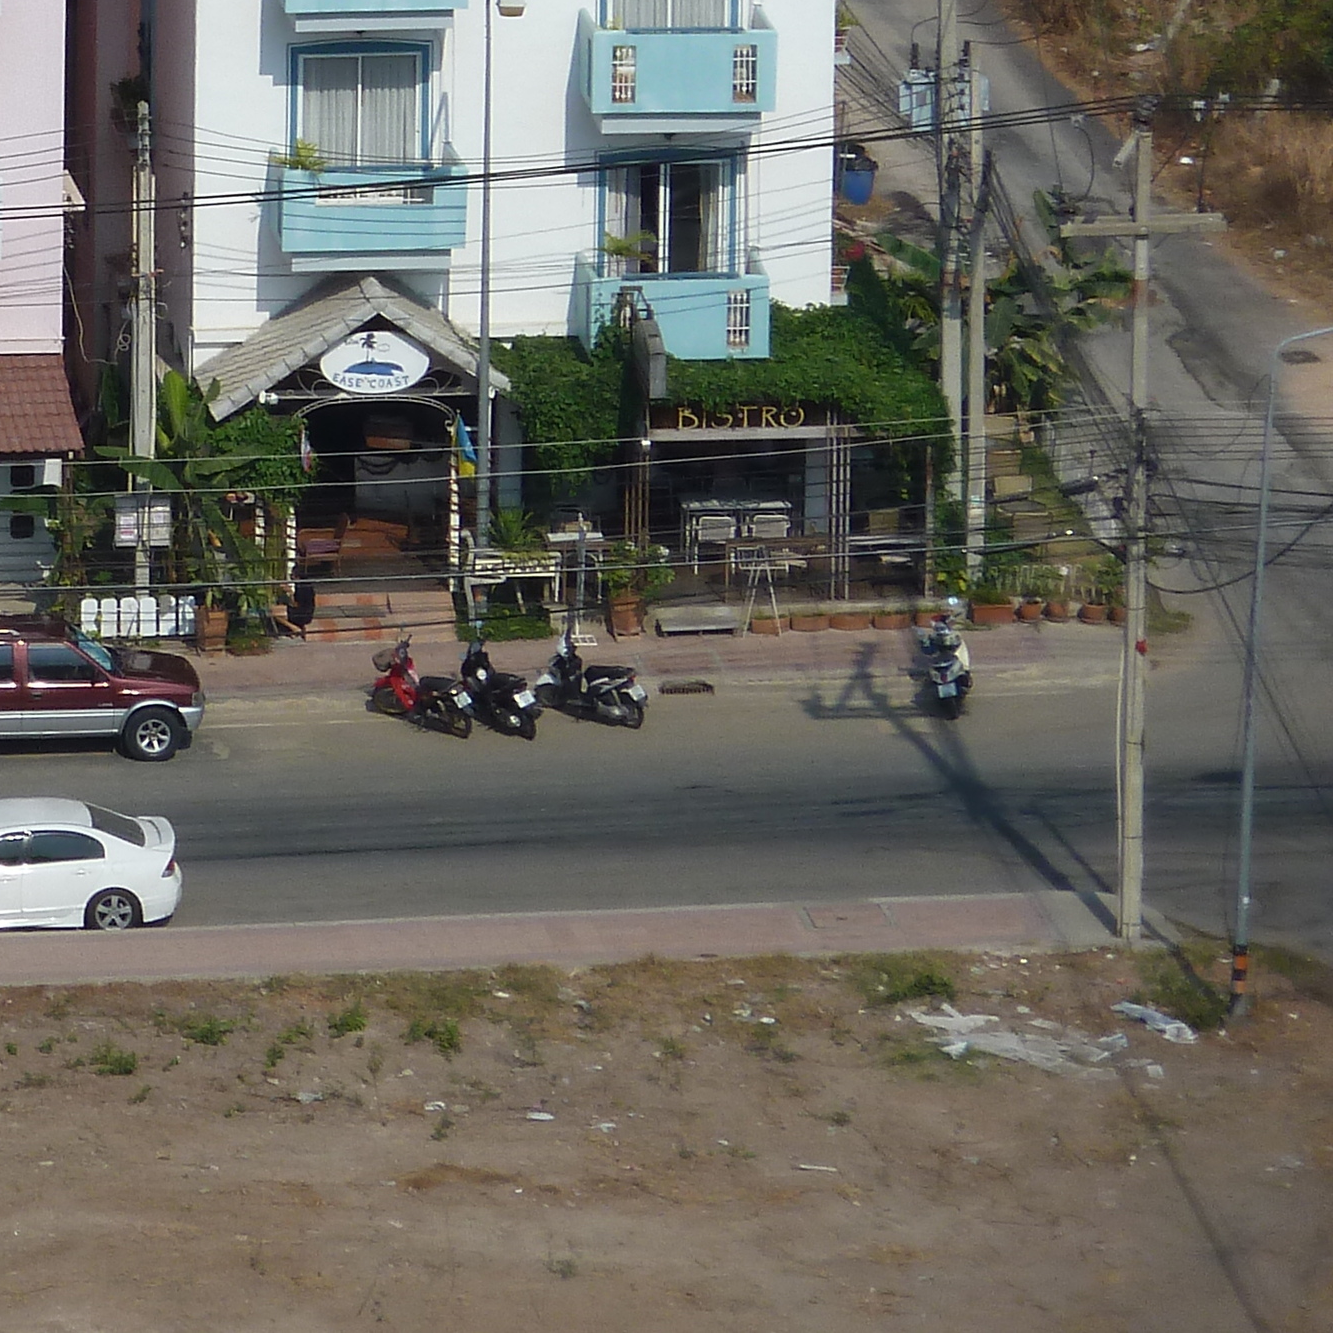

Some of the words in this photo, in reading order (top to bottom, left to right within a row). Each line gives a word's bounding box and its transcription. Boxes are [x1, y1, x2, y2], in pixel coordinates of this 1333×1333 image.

[333, 372, 363, 388] EASE
[367, 375, 410, 389] COAST
[677, 405, 805, 429] BISTRO
